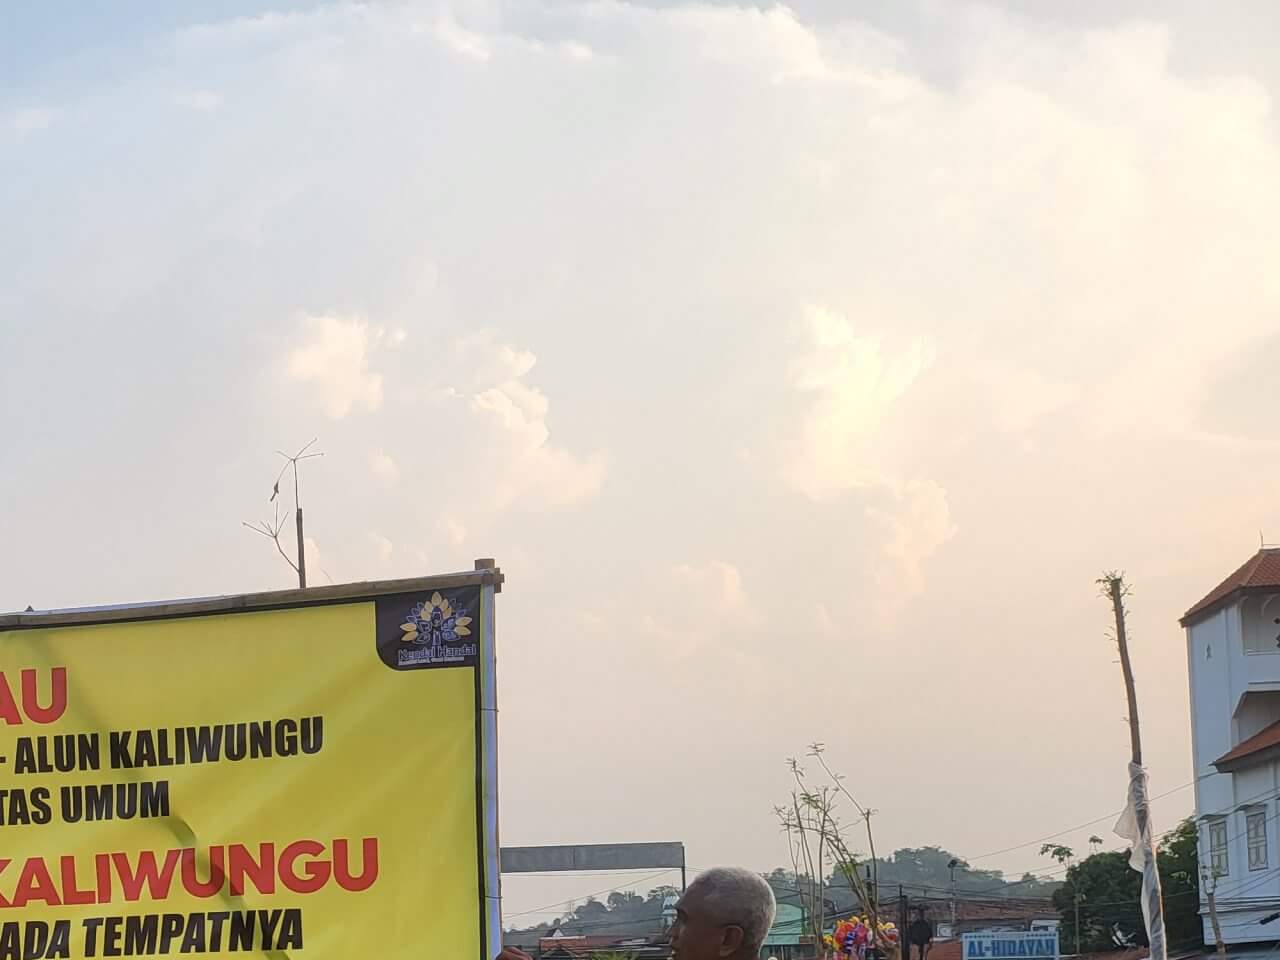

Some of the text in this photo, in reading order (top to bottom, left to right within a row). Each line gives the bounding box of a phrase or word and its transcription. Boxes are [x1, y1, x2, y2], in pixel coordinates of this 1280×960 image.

[14, 732, 99, 774] ALUN
[110, 716, 324, 769] KALIWUNGU
[61, 781, 170, 823] UMUM
[82, 908, 303, 957] TEMPATNYA
